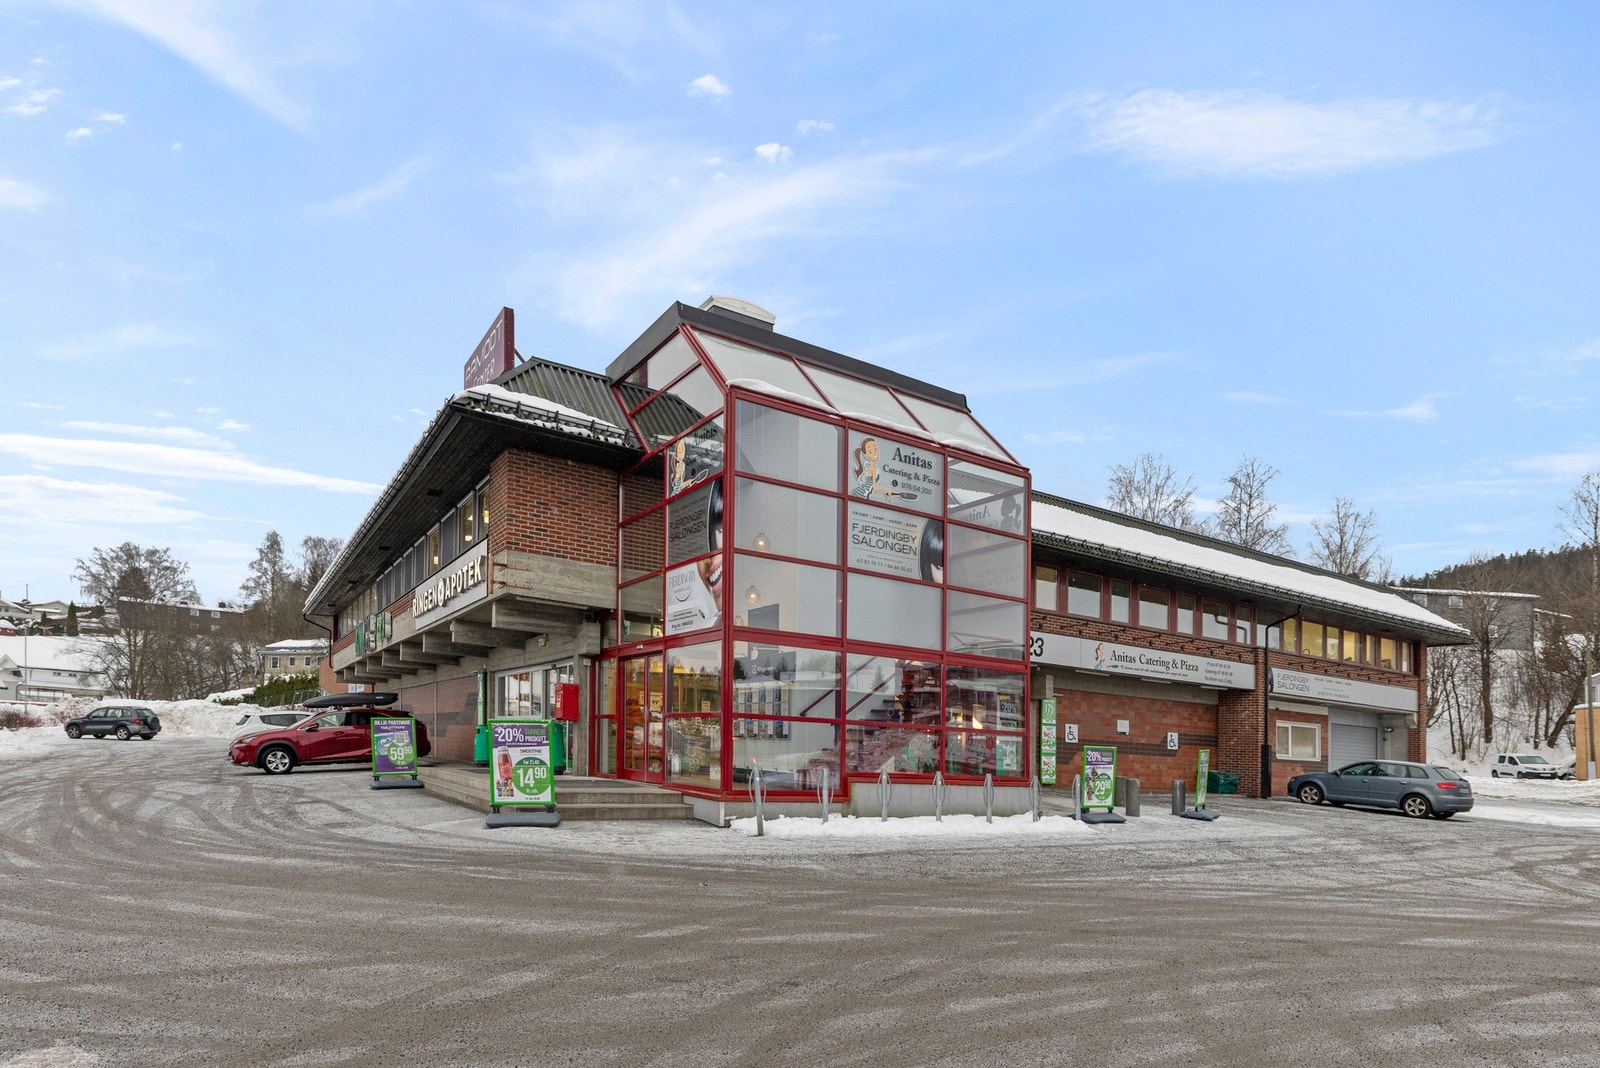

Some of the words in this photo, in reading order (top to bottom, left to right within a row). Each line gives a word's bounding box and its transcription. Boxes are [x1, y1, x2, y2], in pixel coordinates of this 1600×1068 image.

[892, 447, 933, 470] Anitas
[883, 464, 912, 480] Catering
[923, 474, 940, 485] Pizza
[852, 522, 917, 543] FJERDINGBY
[852, 534, 917, 556] SALONGEN
[412, 583, 437, 618] RINGEN
[445, 556, 484, 600] APOTEK
[1110, 650, 1136, 664] Anitas
[1139, 653, 1171, 671] Catering
[1171, 659, 1179, 669] &
[1180, 659, 1199, 672] Pizza
[1277, 673, 1310, 684] FJERDINGBY
[1277, 681, 1310, 693] SALONGEN
[494, 727, 524, 742] -20%
